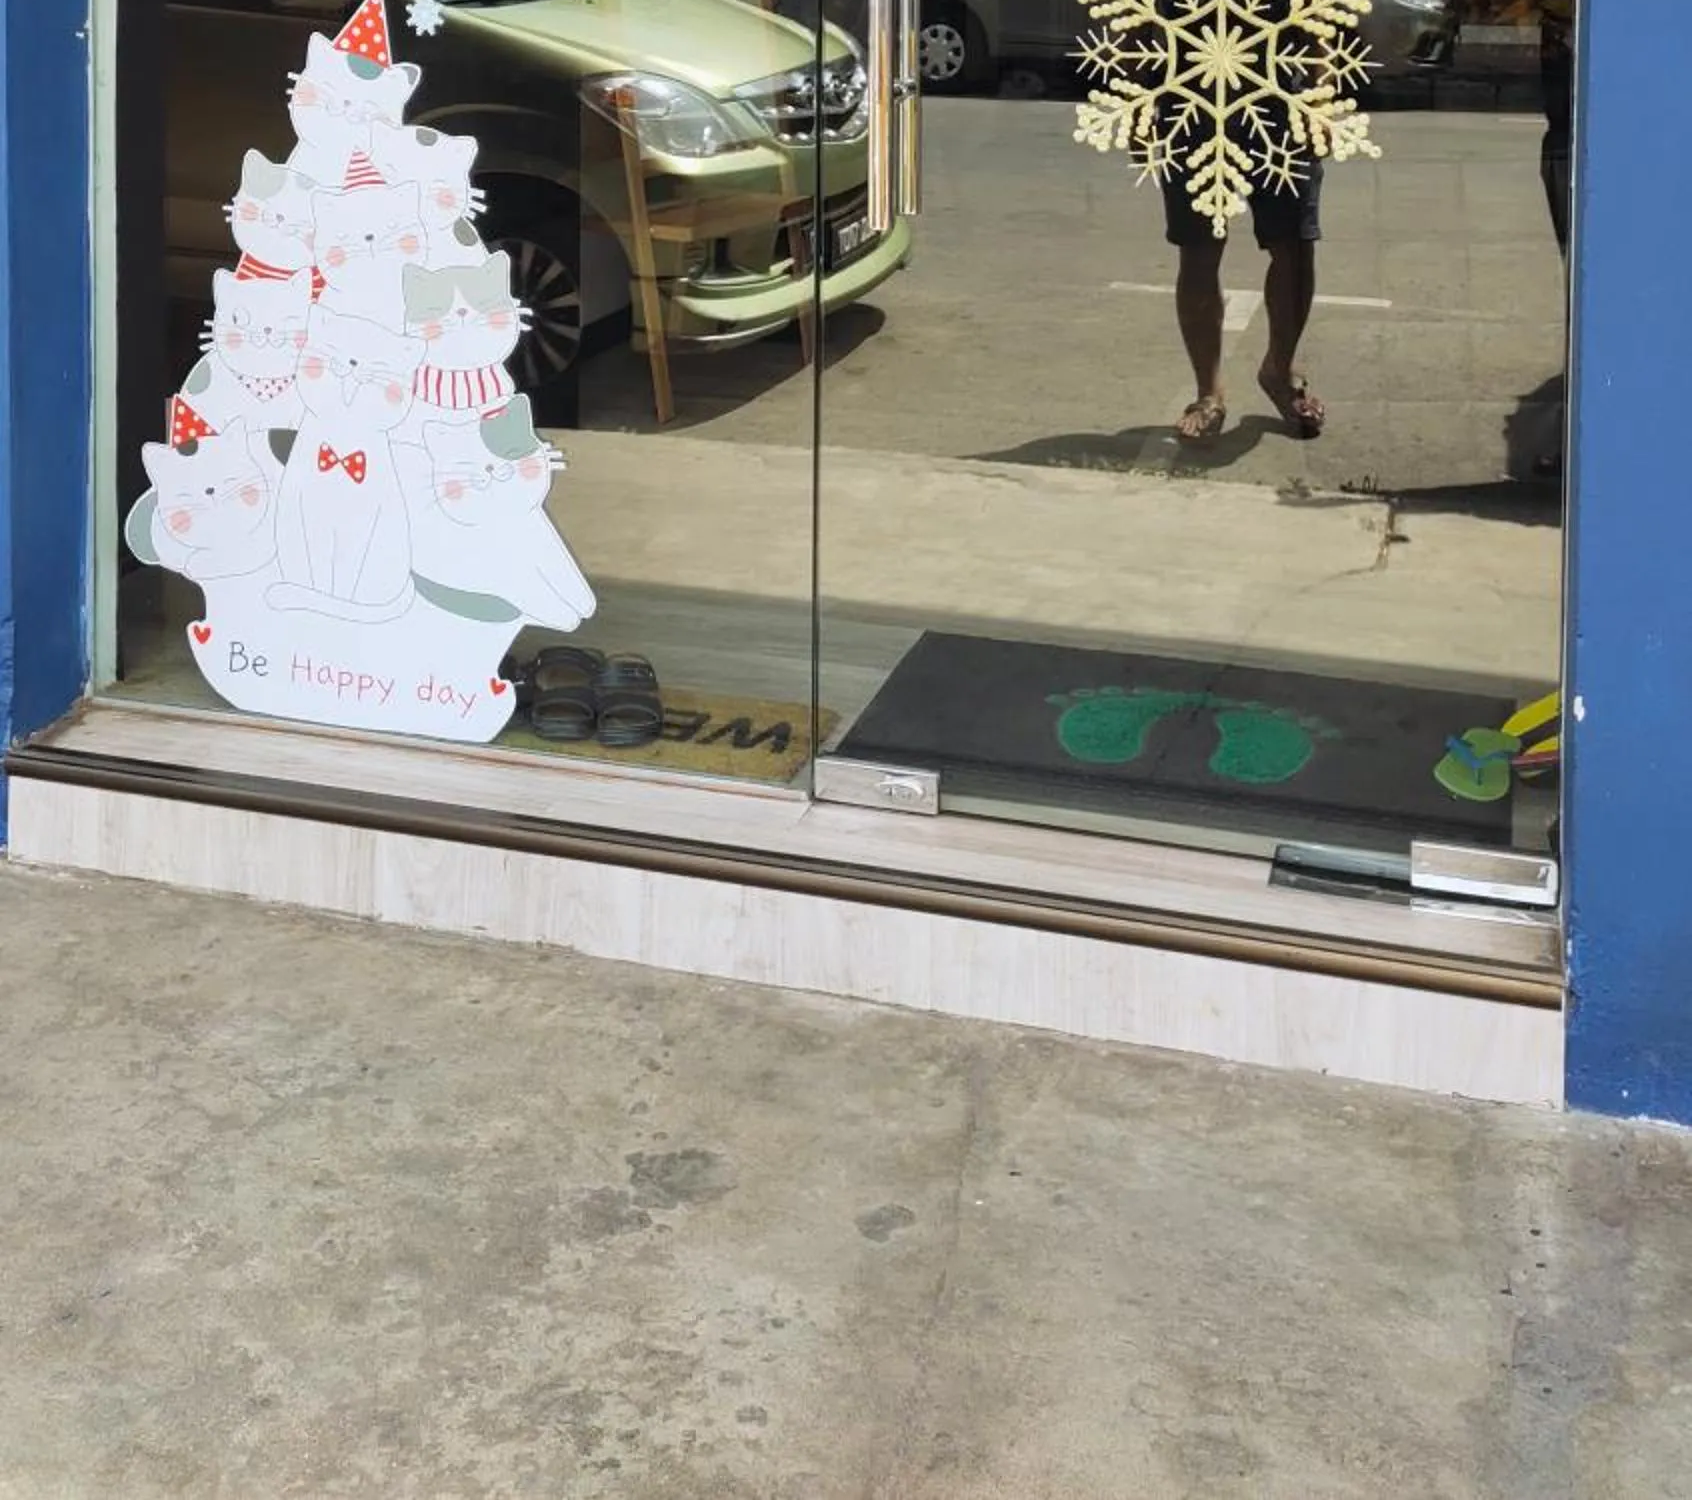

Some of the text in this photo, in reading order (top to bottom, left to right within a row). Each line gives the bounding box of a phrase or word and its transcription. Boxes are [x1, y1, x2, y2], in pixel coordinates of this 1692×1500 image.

[228, 640, 478, 719] Be Happy day
